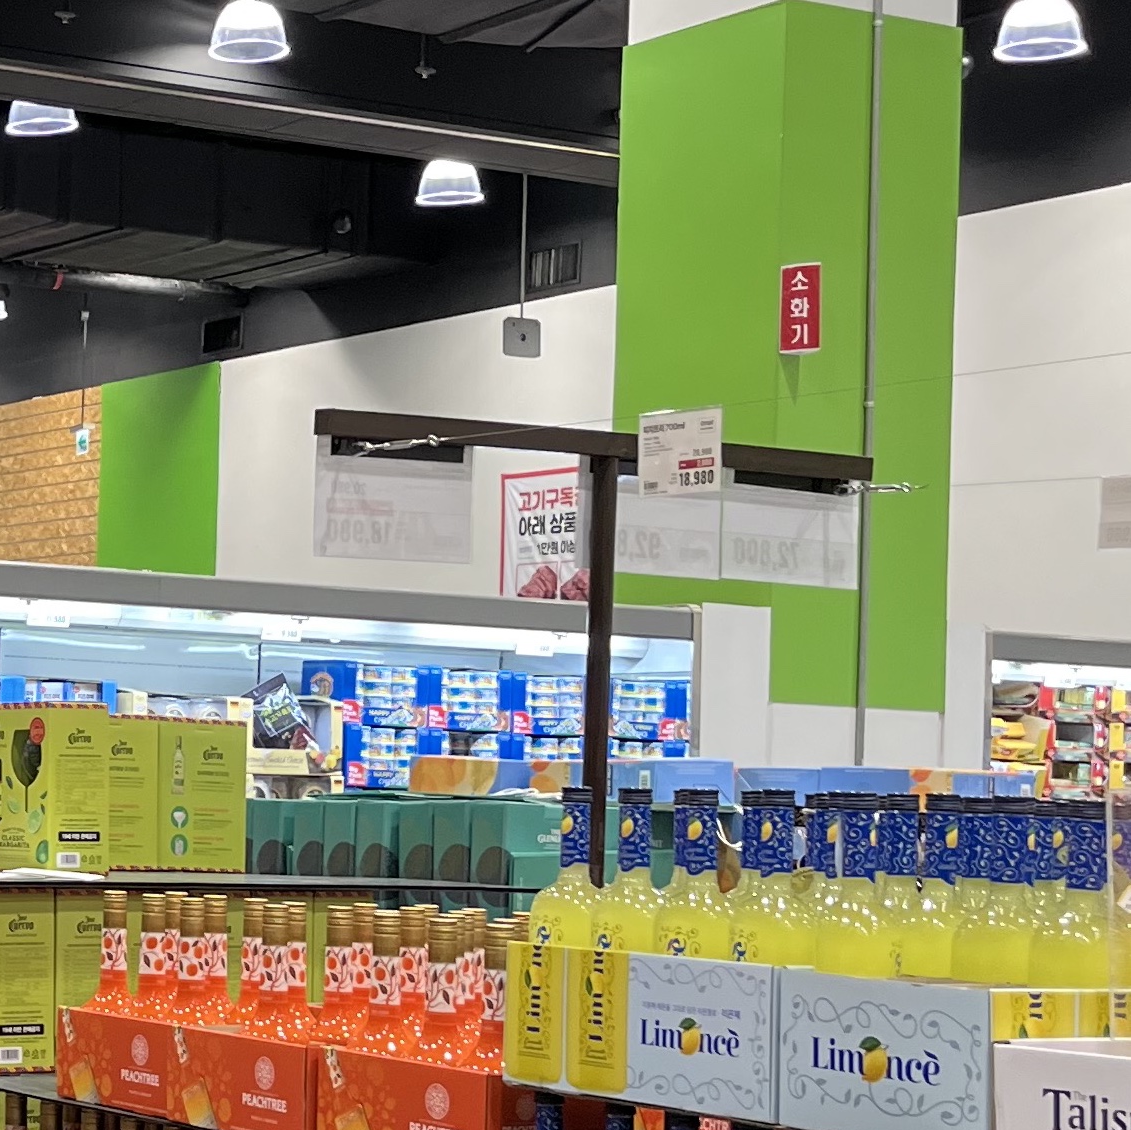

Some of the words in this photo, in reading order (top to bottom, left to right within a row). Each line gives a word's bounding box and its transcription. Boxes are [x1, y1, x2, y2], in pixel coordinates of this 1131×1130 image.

[790, 270, 810, 345] 소화기
[679, 470, 714, 487] 18,980
[120, 1068, 160, 1087] PEACHTREE
[242, 1092, 288, 1114] PEACHTREE
